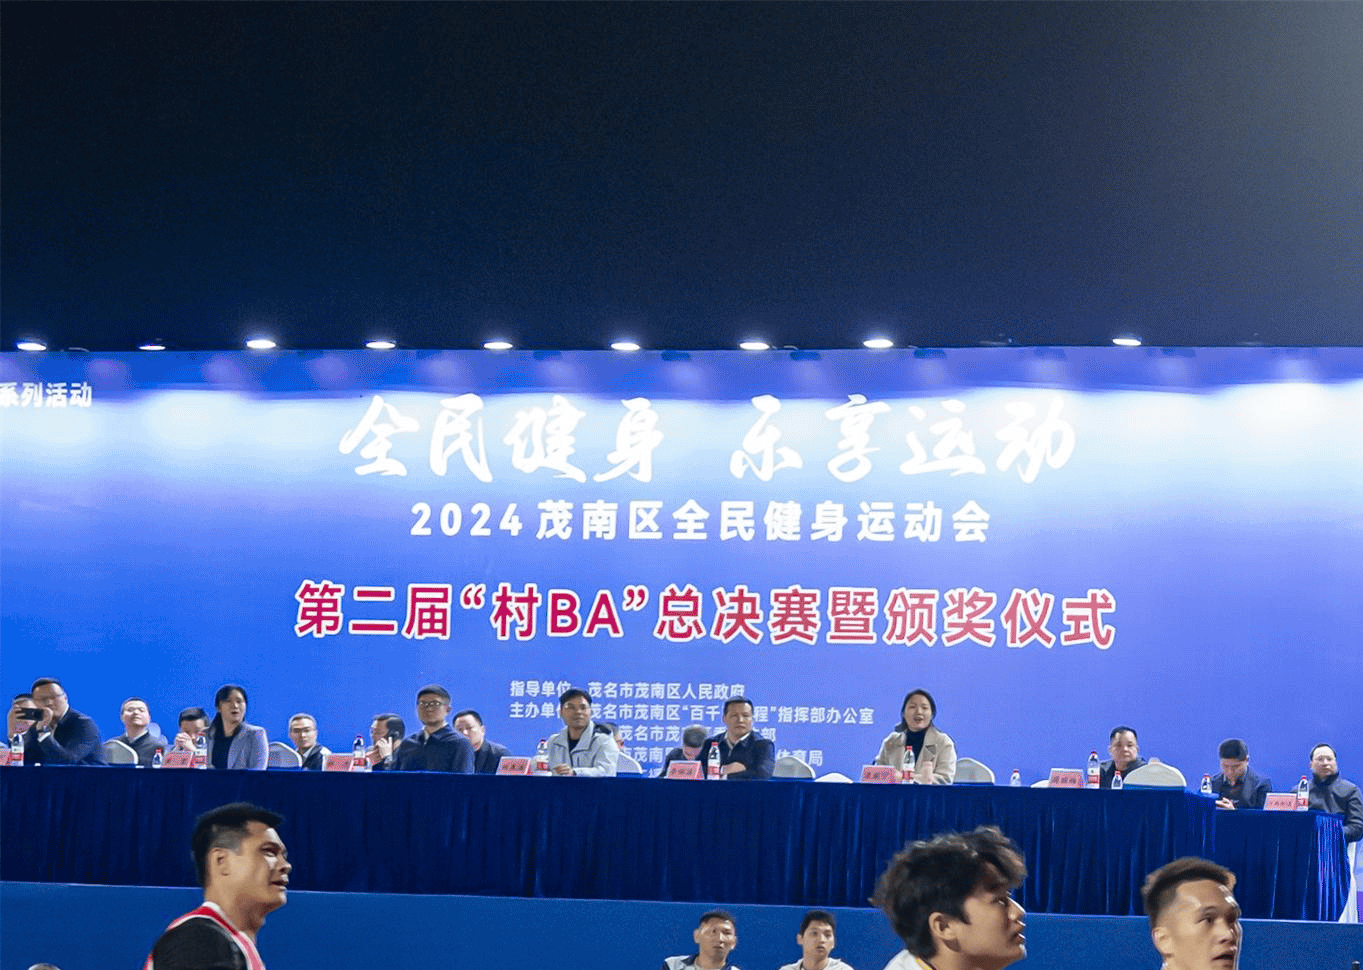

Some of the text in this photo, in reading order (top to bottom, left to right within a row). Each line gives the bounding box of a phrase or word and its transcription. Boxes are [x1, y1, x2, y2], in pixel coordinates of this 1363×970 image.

[338, 393, 1077, 484] 全民健身 乐享运动
[410, 499, 991, 542] 2024茂南区全民健身运动会
[294, 579, 1117, 649] 第二届“村BA”总决赛暨颁奖仪式
[588, 682, 745, 700] 茂名市茂南区人民政府
[590, 703, 875, 725] 茂名市茂南区“百千程”指挥部办公室
